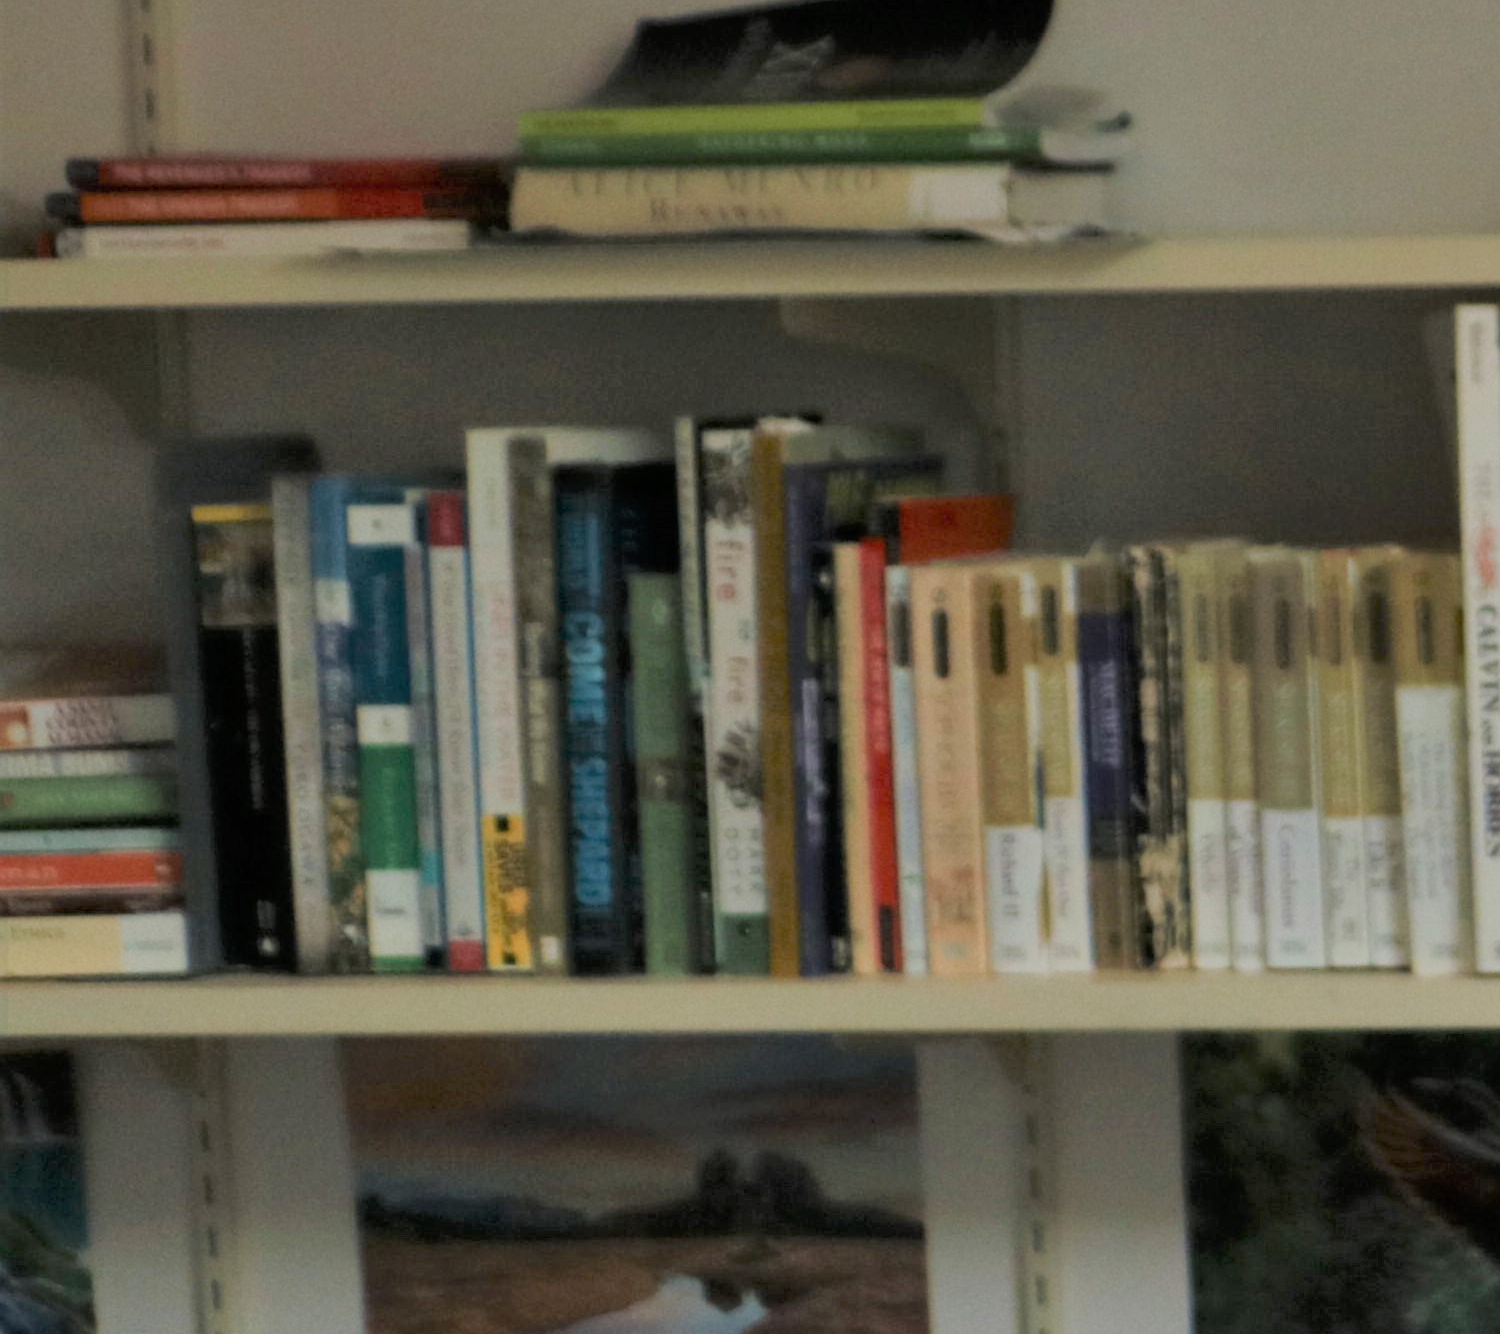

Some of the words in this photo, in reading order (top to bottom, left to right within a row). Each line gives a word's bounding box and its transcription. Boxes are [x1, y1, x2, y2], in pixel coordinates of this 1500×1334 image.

[716, 538, 745, 602] fire
[565, 610, 608, 727] COME
[725, 654, 747, 701] fire
[1475, 603, 1499, 714] CALVIN
[497, 729, 516, 802] WATER
[566, 755, 612, 907] SHEPARD
[726, 826, 740, 898] DOTY
[999, 832, 1016, 897] Richard
